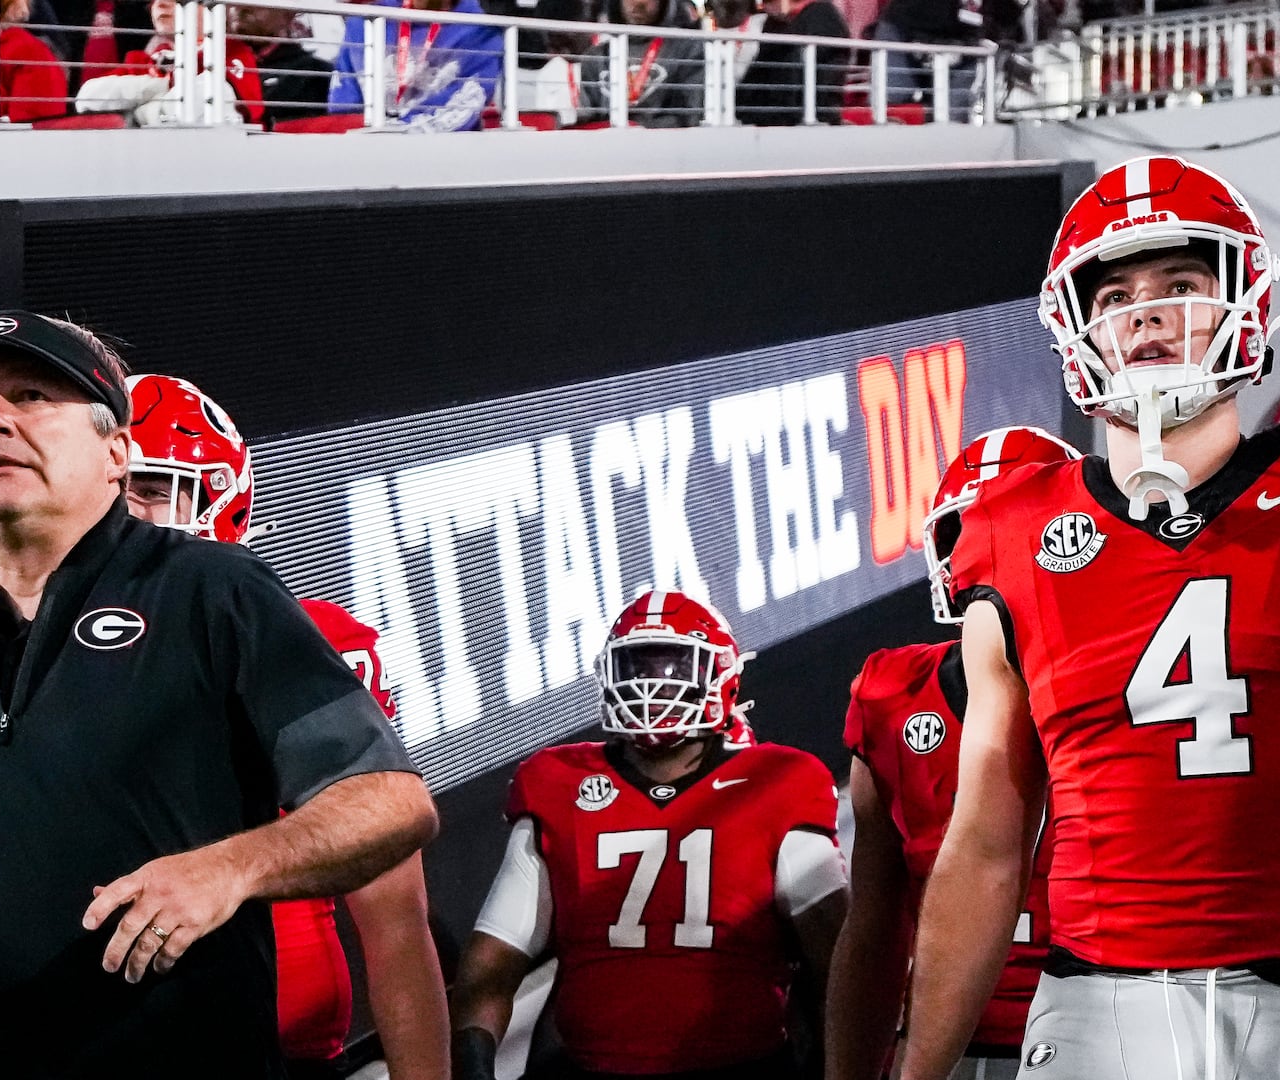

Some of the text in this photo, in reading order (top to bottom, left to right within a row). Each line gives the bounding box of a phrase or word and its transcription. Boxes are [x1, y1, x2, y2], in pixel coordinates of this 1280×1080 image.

[1111, 213, 1168, 232] DAWGS
[347, 338, 967, 748] ATTACK THE DAY
[1044, 513, 1093, 557] SEC
[1042, 545, 1099, 572] GRADUATE
[78, 609, 144, 648] G
[1125, 577, 1252, 778] 4
[906, 713, 942, 751] SEC
[581, 776, 611, 801] SEC
[597, 828, 714, 948] 71
